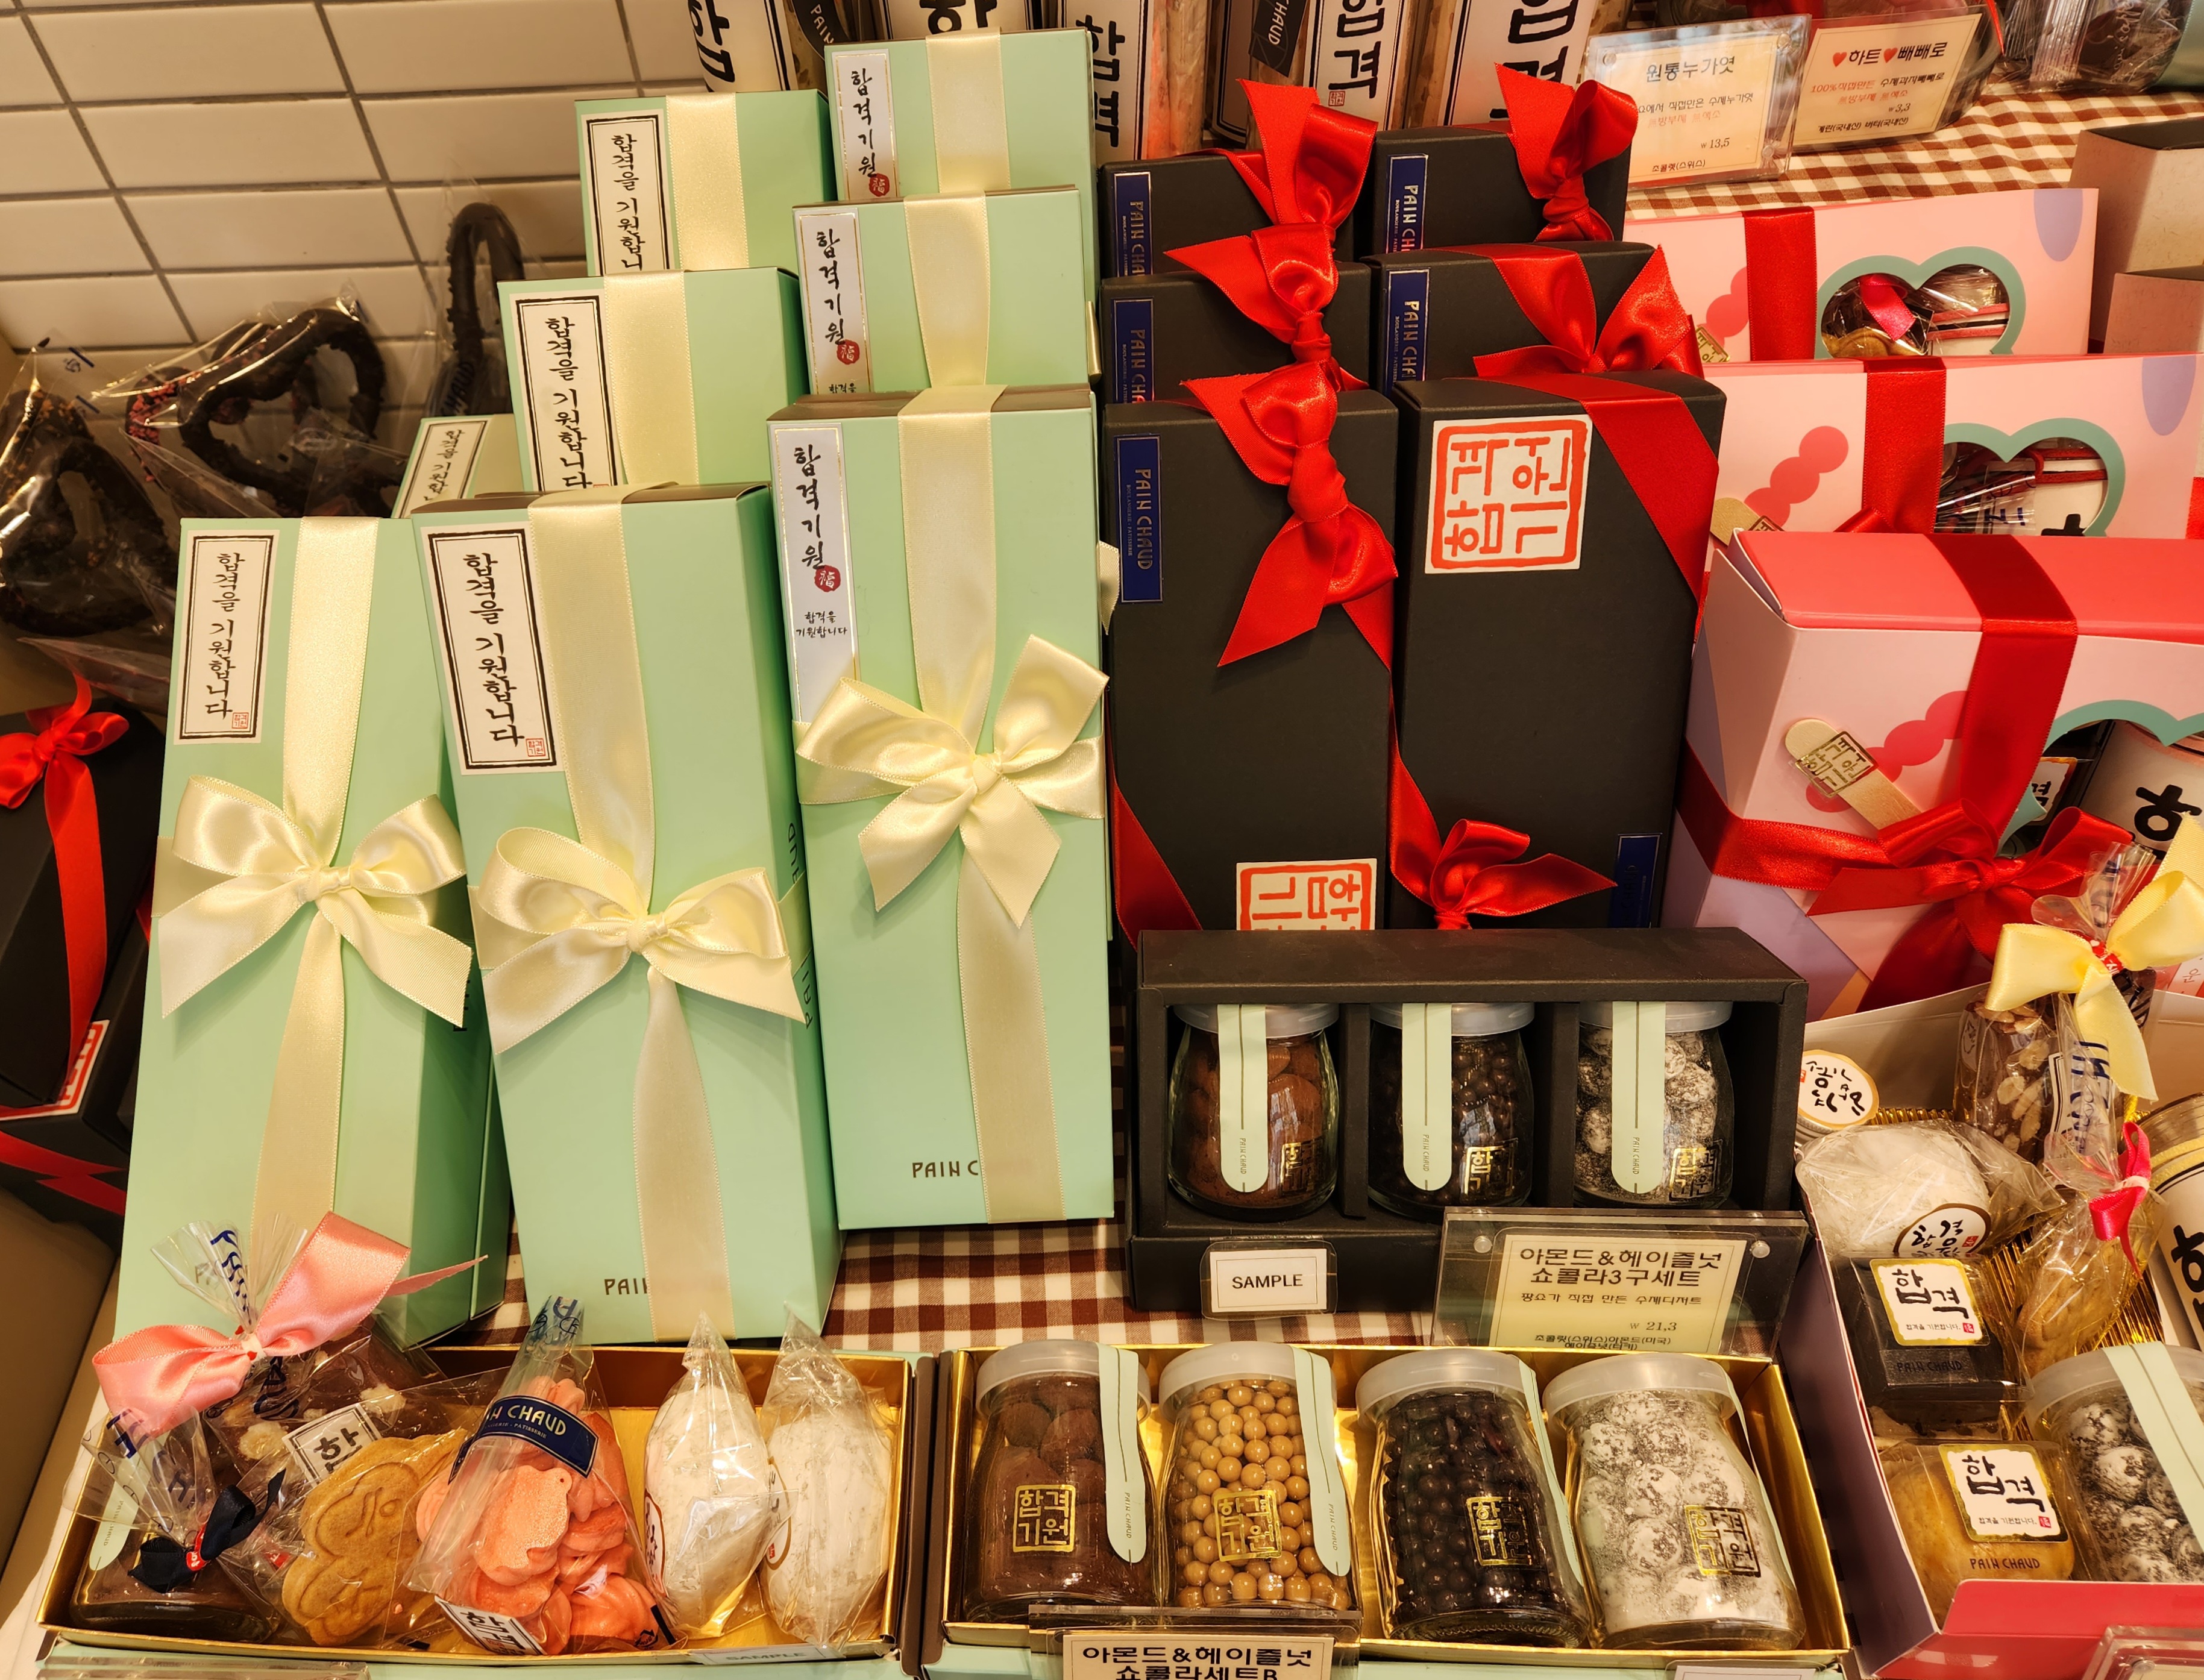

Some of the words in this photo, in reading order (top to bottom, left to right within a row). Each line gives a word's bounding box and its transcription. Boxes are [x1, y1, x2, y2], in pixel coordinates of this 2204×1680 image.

[1646, 56, 1735, 83] 원통누가엿
[1849, 48, 1882, 65] 하트
[1897, 42, 1948, 61] 빼빼로
[1709, 93, 1753, 106] 수제누가엿
[1895, 102, 1911, 113] 3,3
[850, 67, 877, 178] 합격기원
[1709, 138, 1730, 149] 13,5
[611, 133, 639, 191] 합격을
[1130, 201, 1144, 239] PAIN
[1402, 184, 1419, 224] PAIN
[616, 197, 645, 271] 기원합니
[1131, 243, 1145, 276] CHA
[815, 228, 846, 345] 합격기원
[1402, 301, 1420, 341] PAIN
[545, 316, 579, 381] 합격을
[1130, 329, 1146, 368] PAIN
[1401, 346, 1418, 378] CHA
[1131, 373, 1146, 404] CHA
[553, 389, 592, 489] 기원합니다
[424, 462, 451, 501] 기원합
[1135, 469, 1152, 510] PAIN
[794, 444, 826, 570] 합격기원
[1137, 515, 1153, 569] CHAUD
[212, 553, 245, 612] 합격을
[463, 553, 504, 625] 합격을
[796, 627, 848, 638] 기원합니다
[805, 611, 837, 624] 합격을
[204, 619, 236, 719] 기원합니다
[476, 632, 525, 747] 기원합니다
[788, 822, 800, 884] AUD
[1308, 874, 1361, 930] 합
[800, 958, 814, 1029] PAI
[912, 1161, 961, 1179] PAIN
[1520, 1248, 1722, 1270] 아몬드&헤이즐넛
[603, 1278, 649, 1296] PAI
[1232, 1274, 1303, 1289] SAMPLE
[1531, 1267, 1701, 1287] 쇼콜라3구세트
[1892, 1268, 1969, 1318] 합격
[1521, 1293, 1561, 1302] 팡쇼가
[1568, 1294, 1594, 1303] 직접
[1601, 1294, 1627, 1304] 만든
[1635, 1295, 1702, 1306] 수제디저트
[1646, 1321, 1677, 1332] 21,3
[1897, 1362, 1924, 1373] PAIN
[1927, 1361, 1962, 1372] CHAUD
[507, 1405, 567, 1436] CHAUD
[513, 1423, 547, 1439] PATISSERIE
[1962, 1455, 2045, 1512] 합격
[1019, 1490, 1069, 1518] 합격
[1219, 1495, 1272, 1526] 합격
[1018, 1519, 1069, 1546] 기원
[1222, 1524, 1275, 1554] 기원
[1692, 1509, 1748, 1541] 합격
[1700, 1542, 1755, 1570] 기원
[1970, 1558, 2000, 1570] PAIN
[2002, 1558, 2041, 1569] CHAUD
[1082, 1646, 1312, 1667] 아몬드&헤이즐넛
